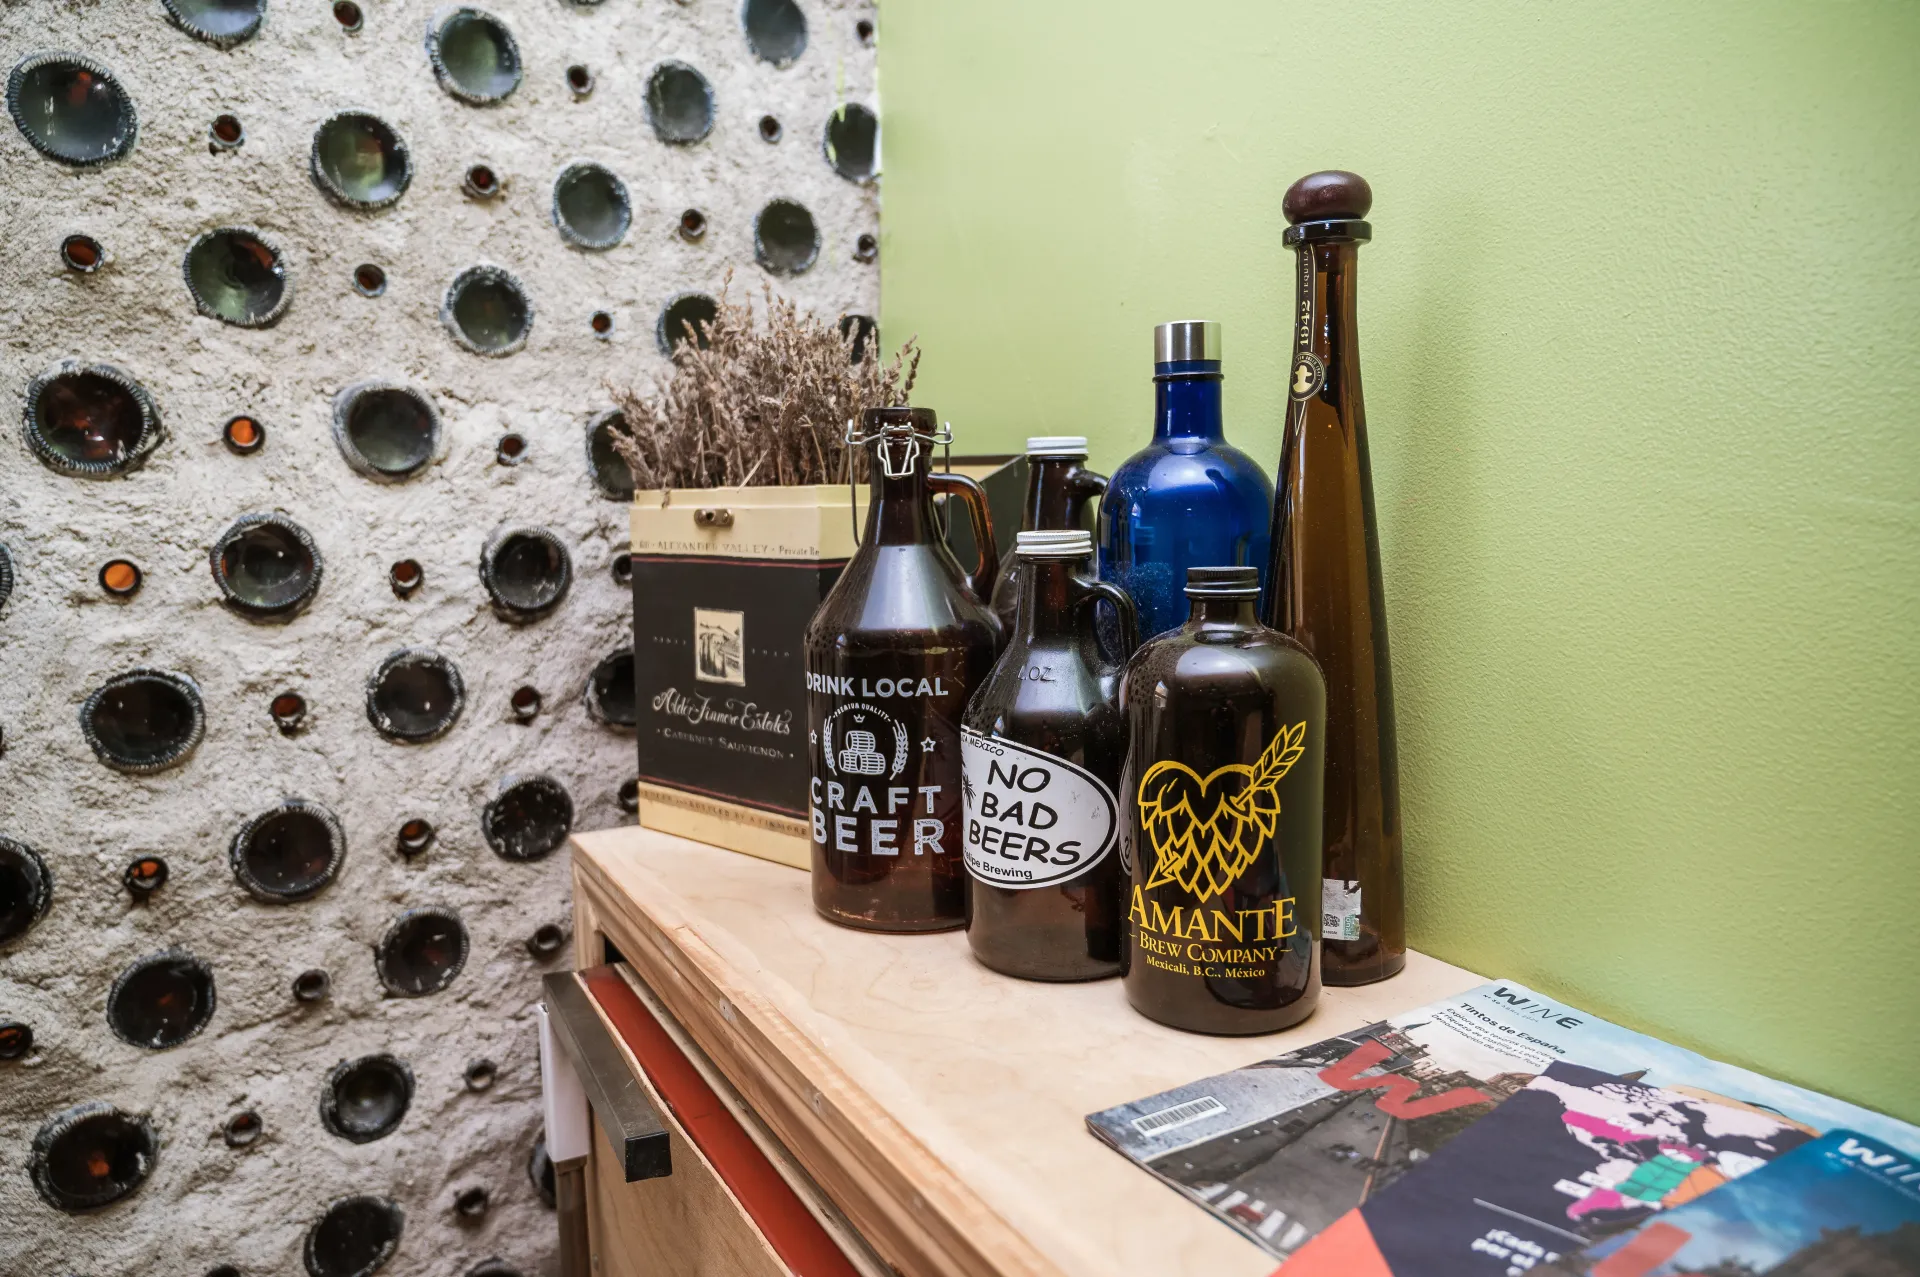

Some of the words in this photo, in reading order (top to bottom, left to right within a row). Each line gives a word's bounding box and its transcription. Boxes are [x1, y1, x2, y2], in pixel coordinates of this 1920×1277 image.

[1300, 299, 1311, 346] 1942
[723, 543, 768, 554] VALLEY
[806, 670, 855, 697] DRINK
[861, 677, 949, 698] LOCAL
[727, 698, 793, 735] Estates
[861, 702, 889, 720] QUALITY
[718, 736, 784, 758] SAUVIGNON
[970, 737, 1004, 756] MEXICO
[987, 759, 1051, 794] NO
[811, 776, 942, 814] CRAFT
[980, 791, 1059, 830] BAD
[812, 806, 945, 857] BEER
[968, 820, 1082, 866] BEERS
[983, 861, 1033, 880] Brewing
[1127, 884, 1297, 943] AMANTE
[1139, 930, 1182, 958] BREW
[1186, 943, 1278, 964] COMPANY
[1146, 954, 1190, 976] Mexicali,
[1225, 966, 1266, 978] México
[1447, 1008, 1475, 1027] Explora
[1493, 986, 1584, 1030] WINE
[1460, 1003, 1500, 1026] Tintos
[1499, 1024, 1516, 1035] de
[1517, 1032, 1566, 1054] España
